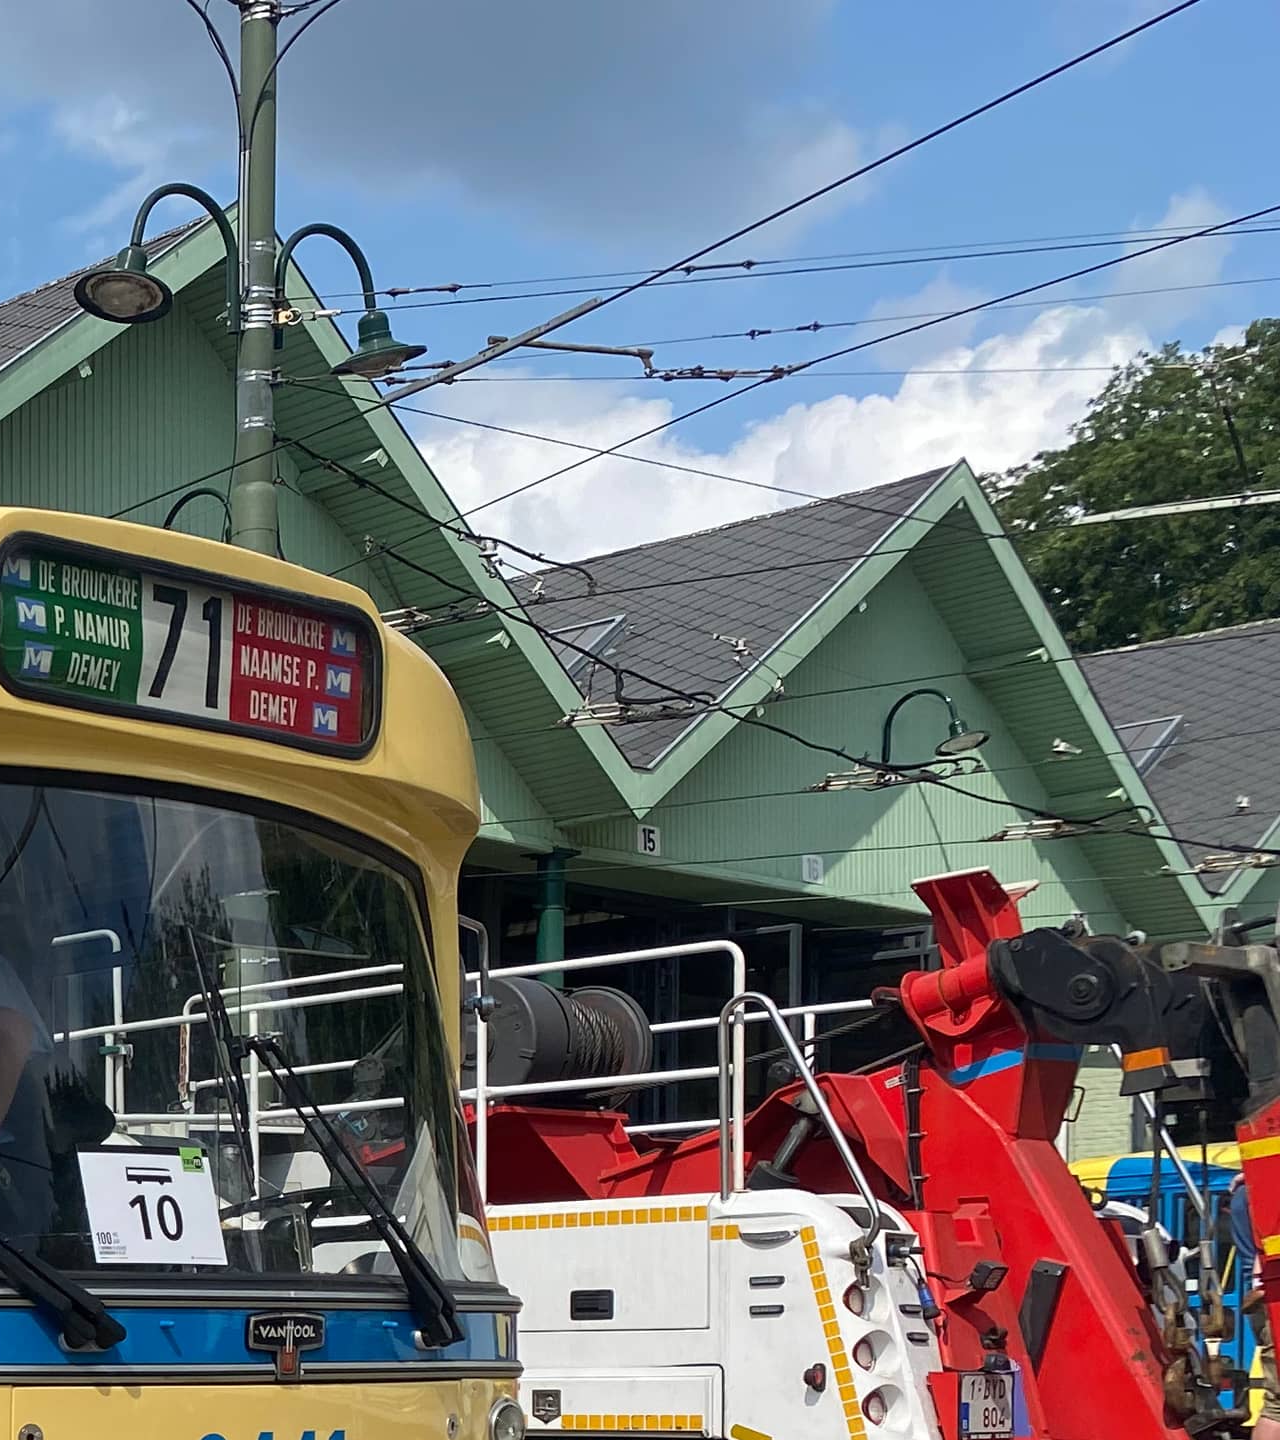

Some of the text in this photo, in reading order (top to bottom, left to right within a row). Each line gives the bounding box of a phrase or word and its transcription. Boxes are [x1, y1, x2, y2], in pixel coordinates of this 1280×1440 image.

[39, 560, 56, 593] DE
[61, 564, 139, 611] BROUCKERE
[54, 604, 70, 637] P.
[73, 608, 131, 651] NAMUR
[148, 583, 221, 709] 71
[237, 603, 253, 635] DE
[257, 607, 325, 651] BROUCKERE
[66, 650, 121, 692] DEMEY
[240, 644, 301, 687] NAAMSE
[306, 660, 320, 691] P.
[249, 689, 298, 727] DEMEY
[642, 827, 656, 853] 15
[807, 857, 820, 881] 16
[95, 1231, 113, 1245] 100
[128, 1194, 184, 1242] 10
[983, 1407, 1006, 1428] 804
